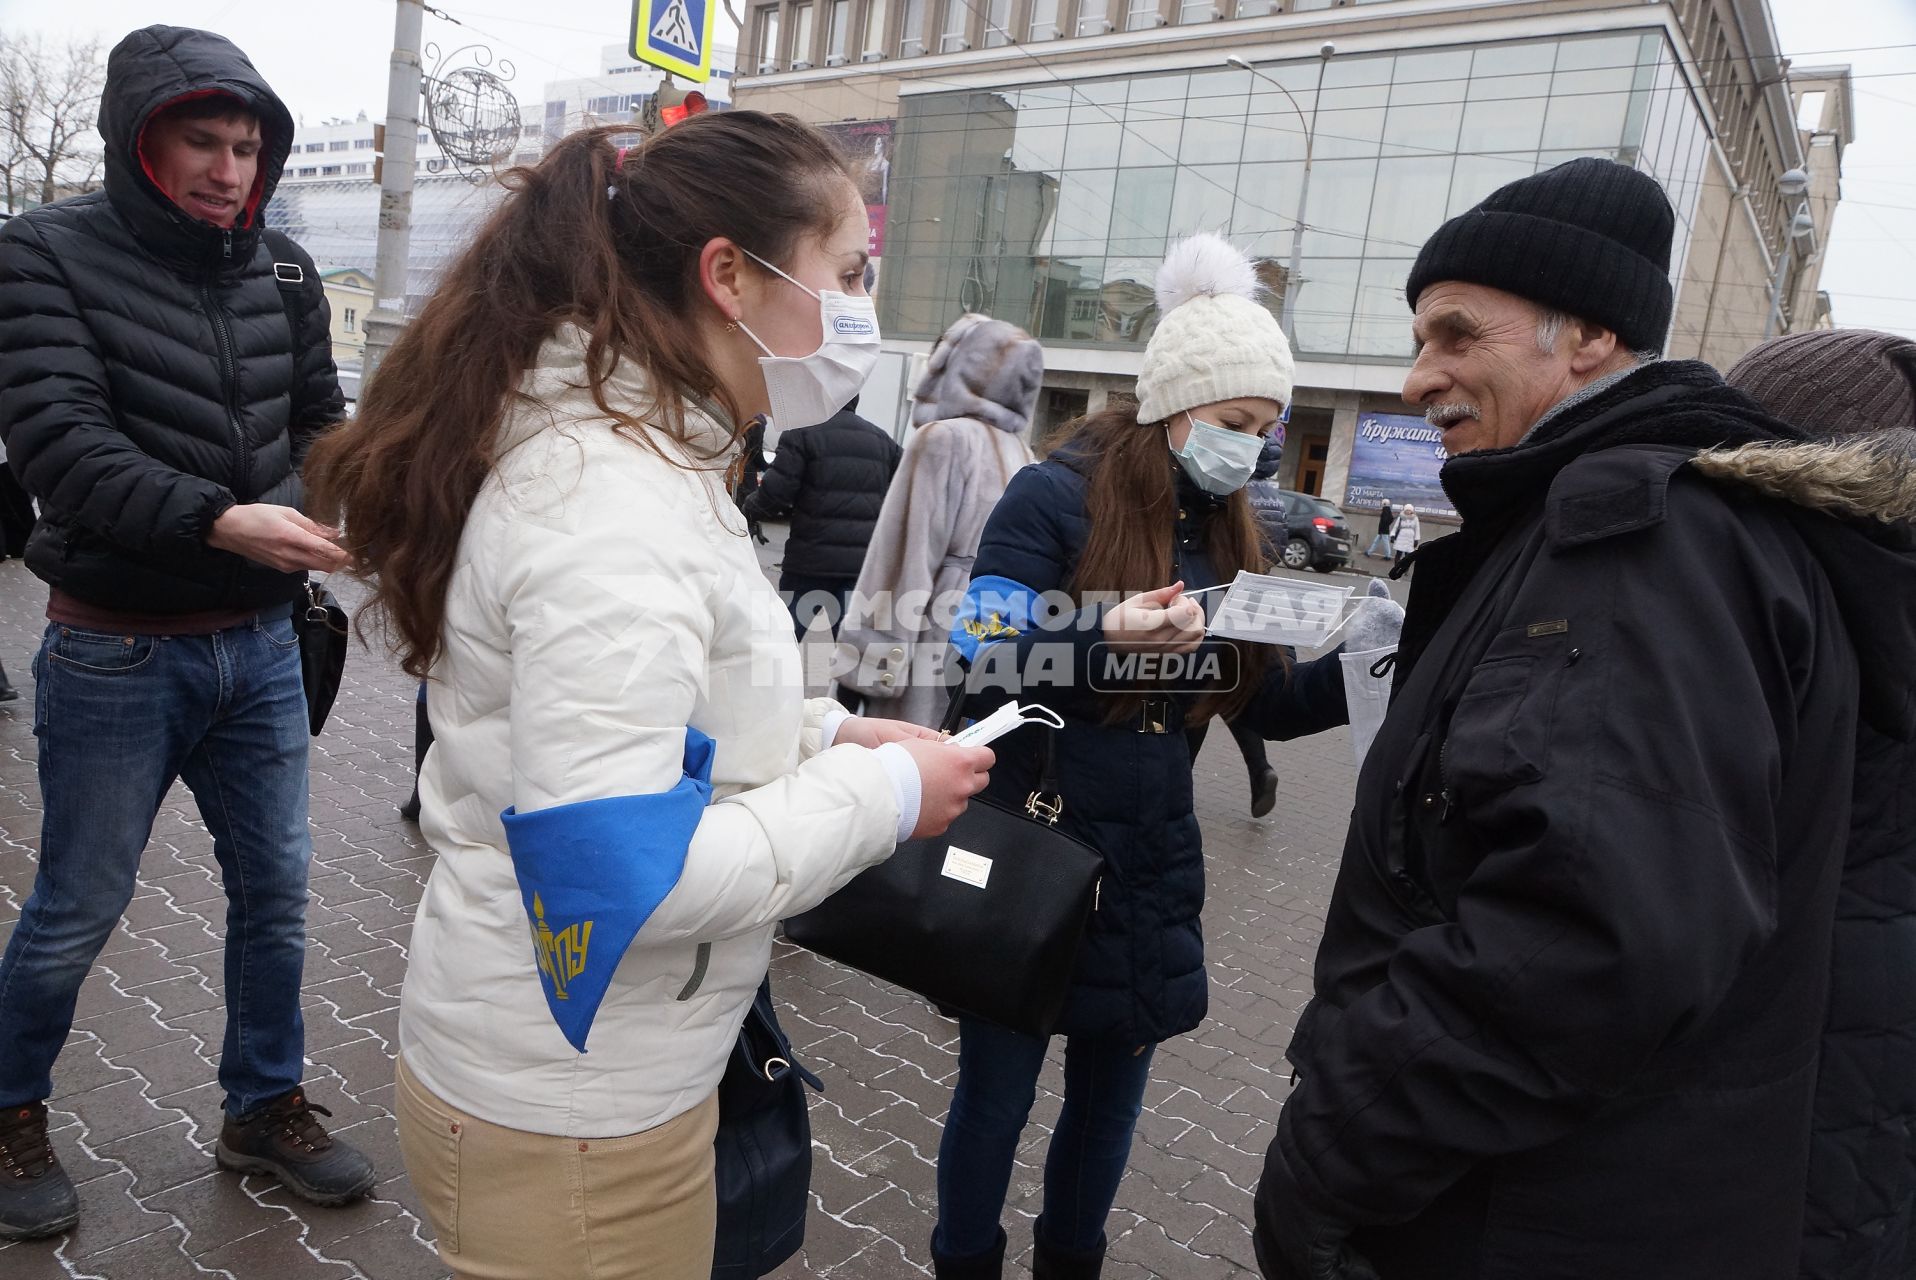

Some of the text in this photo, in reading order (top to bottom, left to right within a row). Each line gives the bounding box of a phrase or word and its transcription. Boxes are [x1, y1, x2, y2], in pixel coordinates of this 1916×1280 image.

[1362, 419, 1442, 443] Кружатс
[1351, 486, 1361, 495] 20
[1349, 495, 1355, 504] 2
